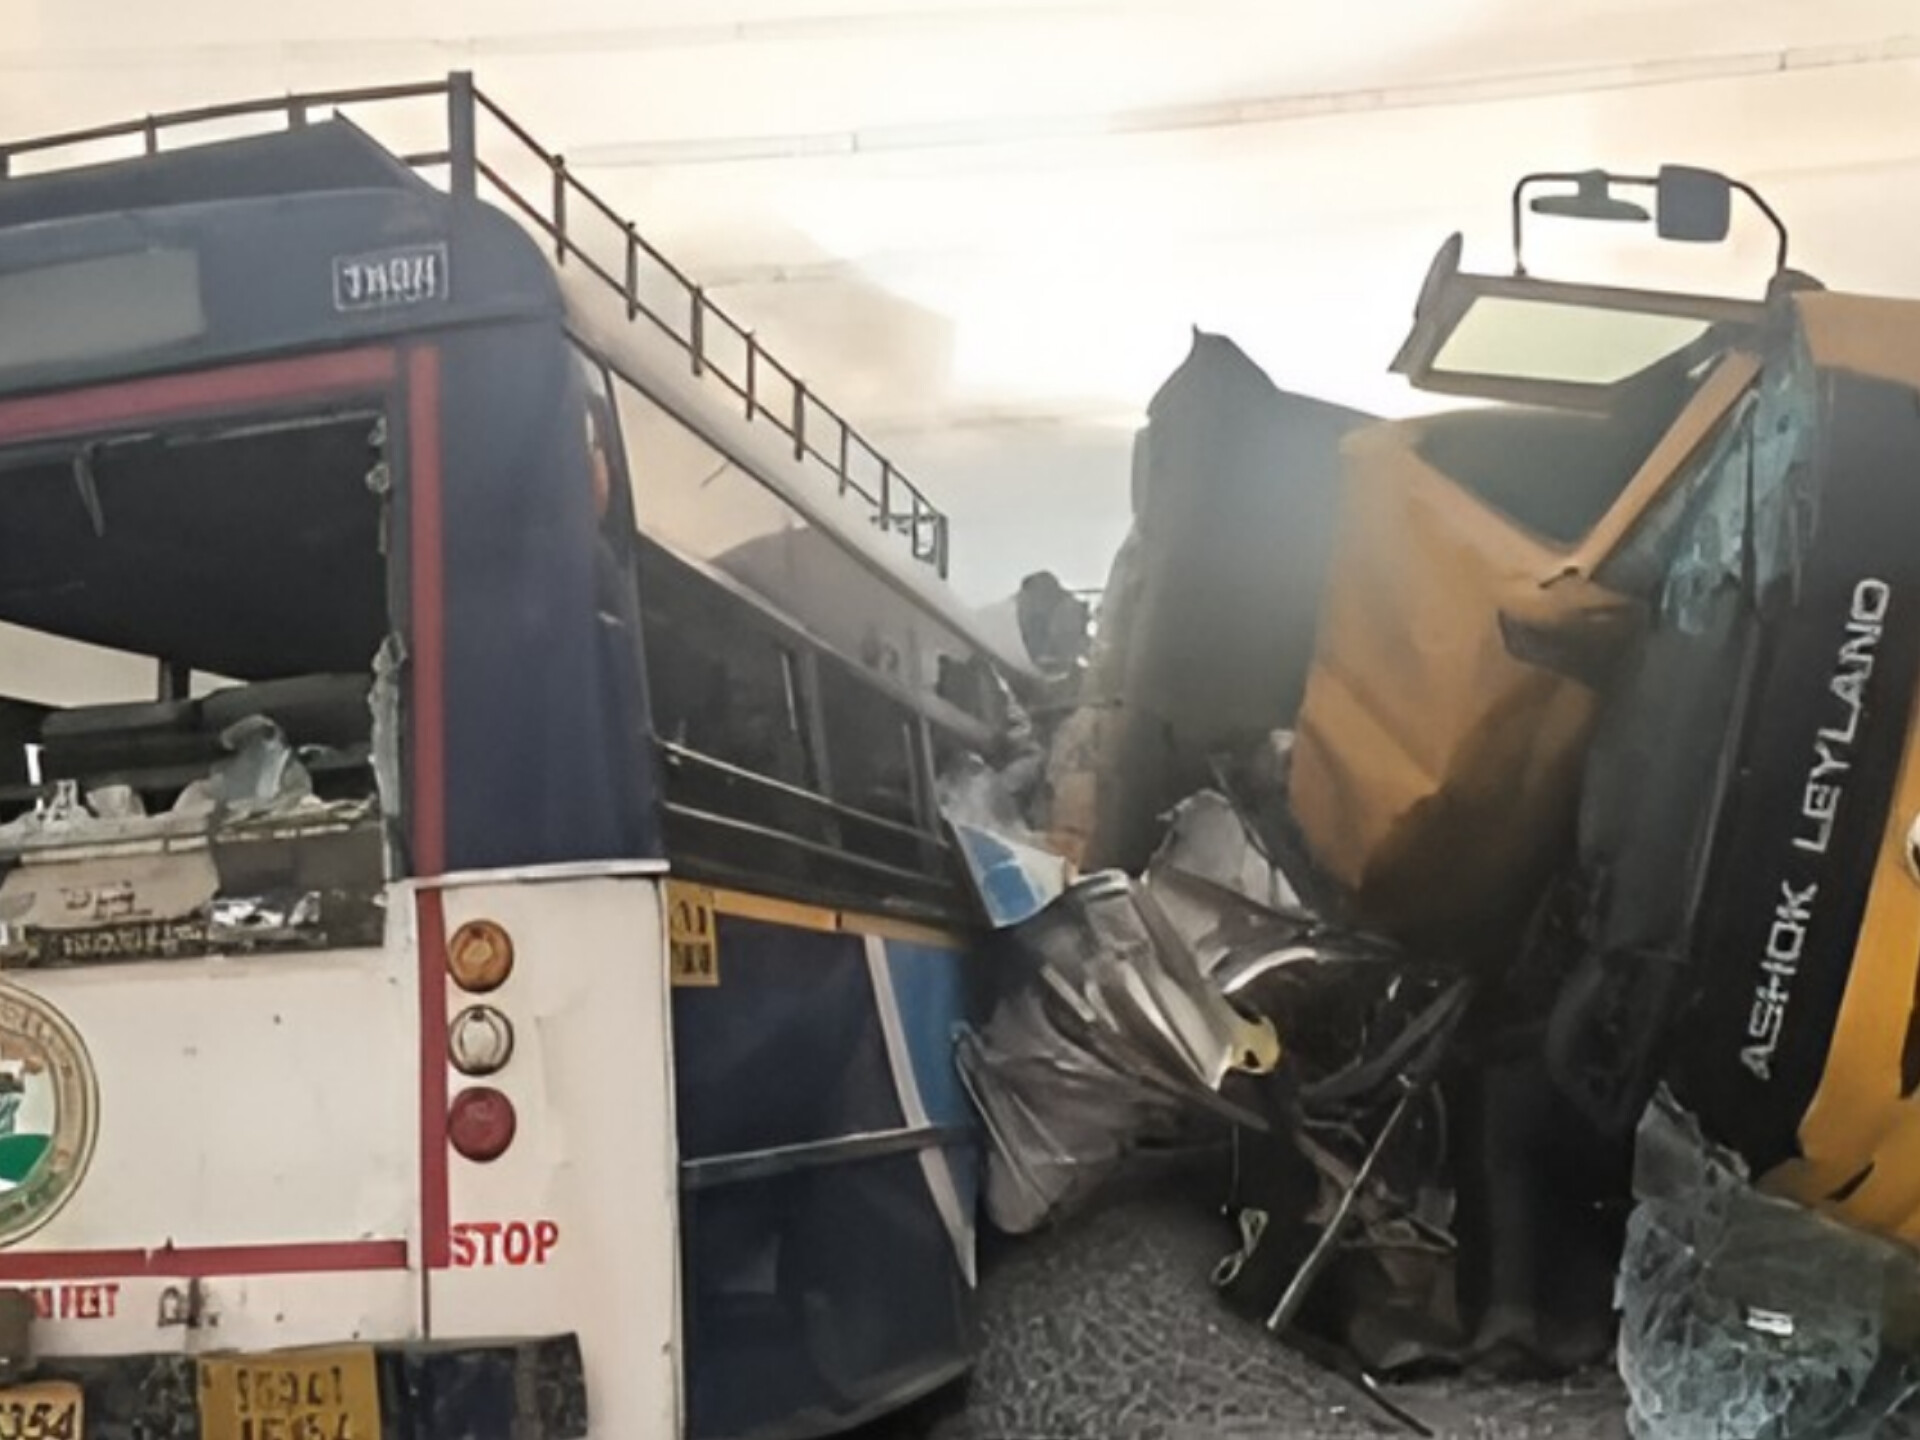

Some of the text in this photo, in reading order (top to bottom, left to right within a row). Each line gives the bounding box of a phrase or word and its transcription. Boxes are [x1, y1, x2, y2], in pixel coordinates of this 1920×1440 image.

[1740, 577, 1890, 1081] ASHOK LEYLAND
[452, 1219, 559, 1267] STOP
